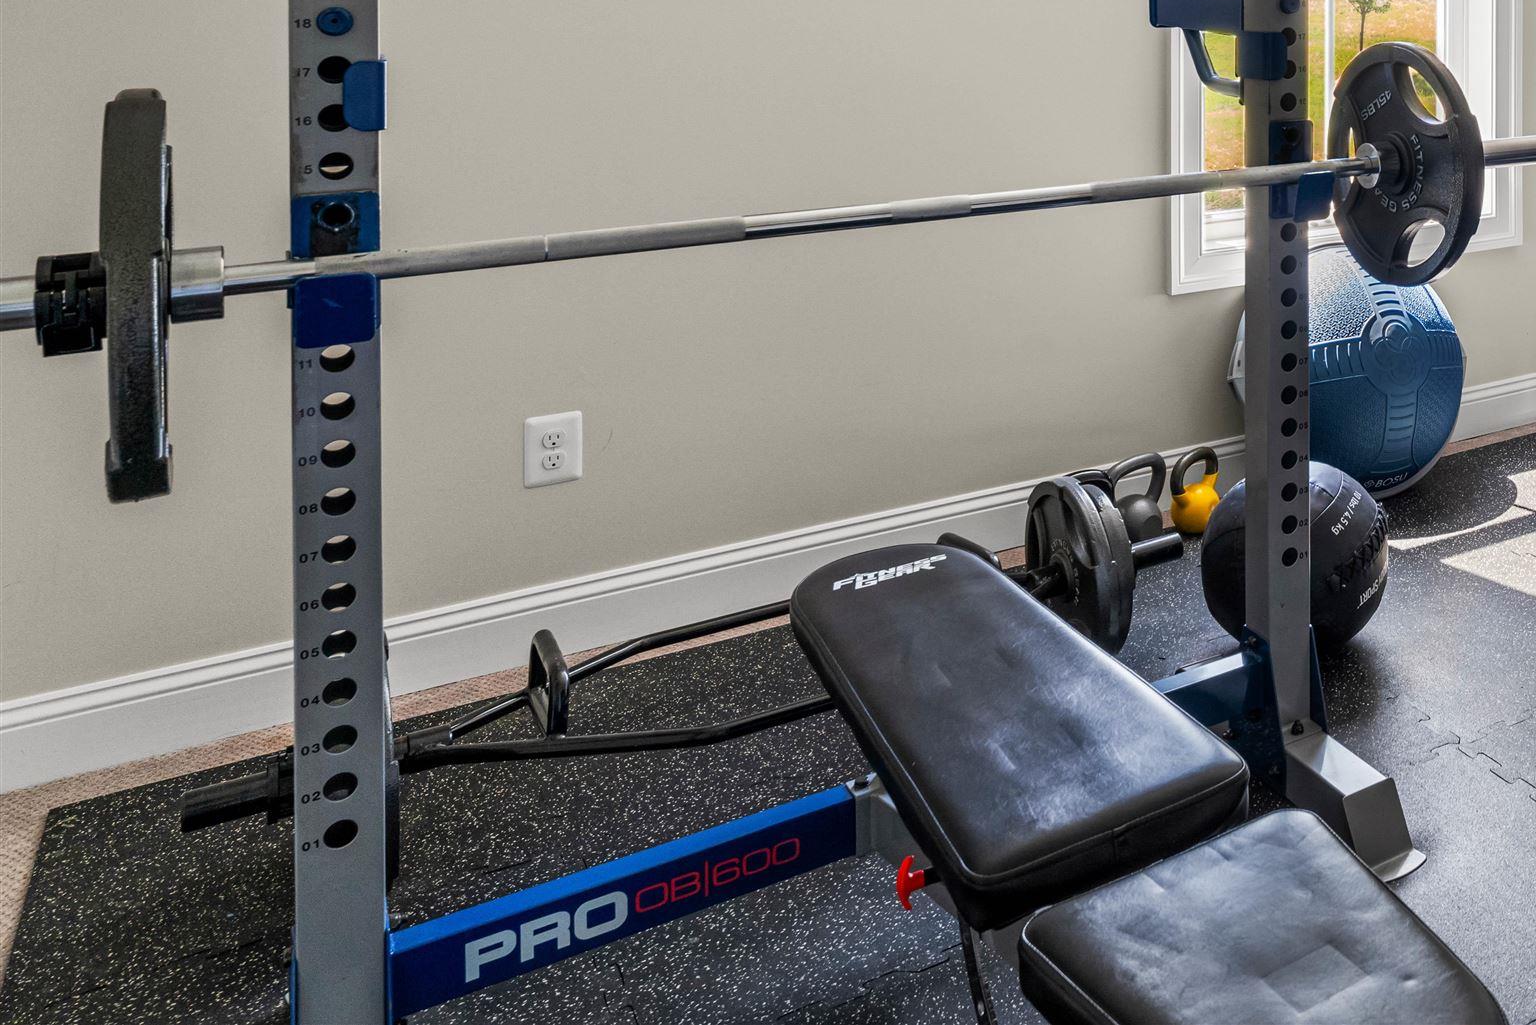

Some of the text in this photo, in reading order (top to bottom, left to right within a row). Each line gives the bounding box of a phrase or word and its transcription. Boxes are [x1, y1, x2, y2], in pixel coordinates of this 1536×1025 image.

[294, 18, 312, 28] 18
[295, 116, 312, 126] 16
[1373, 133, 1425, 214] FITNESS GEA
[298, 359, 312, 370] 11
[298, 407, 316, 418] 10
[298, 455, 318, 467] 09
[1375, 472, 1408, 488] BOSU
[1353, 490, 1362, 499] 10
[299, 503, 319, 515] 08
[1349, 497, 1359, 509] lbs
[1340, 510, 1352, 526] 4.5
[1331, 522, 1345, 536] kg
[300, 551, 319, 563] 07
[300, 599, 320, 611] 06
[301, 647, 320, 660] 05
[301, 695, 320, 708] 04
[301, 743, 321, 756] 03
[302, 791, 321, 804] 02
[302, 839, 321, 852] 01
[464, 890, 629, 983] PRO
